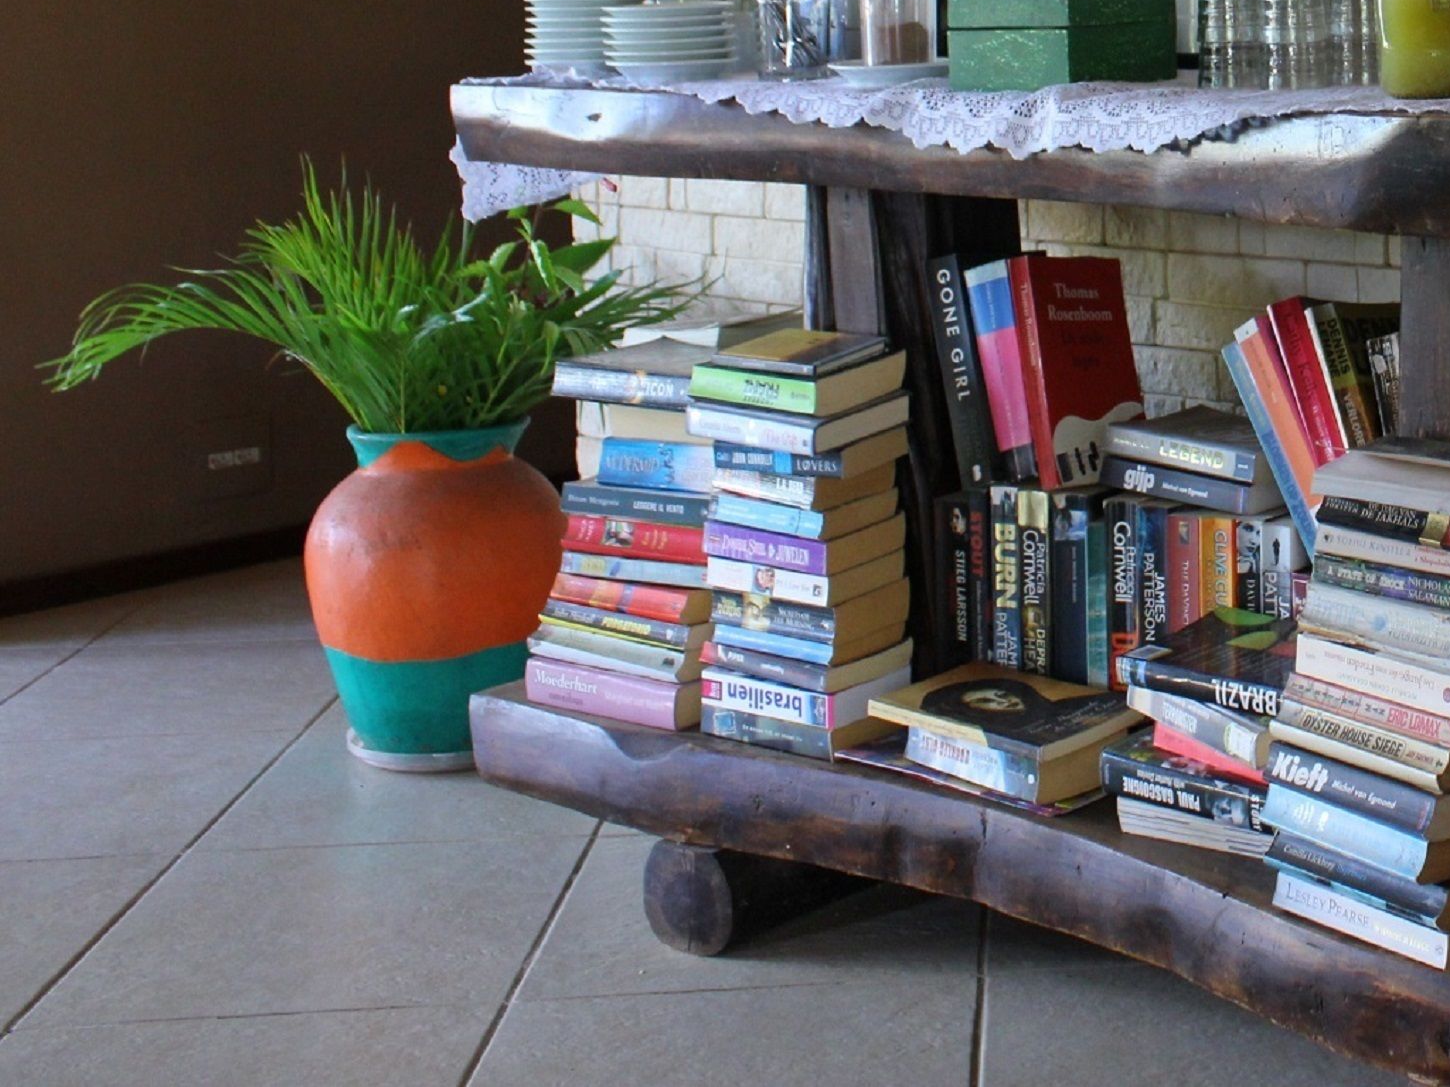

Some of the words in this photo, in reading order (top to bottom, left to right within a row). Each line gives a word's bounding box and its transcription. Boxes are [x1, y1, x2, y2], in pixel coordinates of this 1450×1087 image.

[1053, 282, 1100, 299] Thomas
[1048, 304, 1113, 322] Rosenboom
[936, 269, 961, 338] GONE
[951, 347, 971, 401] GIRL
[1327, 318, 1350, 375] DENNIS
[1159, 438, 1224, 469] LEGEND
[1123, 464, 1155, 493] gijp
[955, 549, 967, 584] STIEG
[994, 523, 1018, 609] BURN
[1023, 530, 1040, 604] Cornwell
[1036, 542, 1046, 594] Patricia
[1113, 521, 1133, 603] Cornwell
[1213, 530, 1229, 579] CLIVE
[956, 587, 968, 641] LARSSON
[1142, 552, 1156, 641] PATTERSON
[1153, 572, 1166, 624] JAMES
[1214, 581, 1229, 608] CU
[1246, 579, 1256, 611] DAVI
[1006, 631, 1018, 670] JAM
[533, 668, 598, 695] Moederhart
[727, 682, 803, 718] brasilien
[1211, 678, 1278, 716] BRAZIL
[1302, 711, 1341, 736] OYSTER
[1341, 723, 1373, 749] HOUSE
[1373, 735, 1405, 759] SIEGE
[1387, 706, 1408, 729] ERIC
[1408, 712, 1442, 739] LOMAX
[1271, 750, 1329, 794] Kieft
[1354, 787, 1368, 799] van
[1367, 791, 1397, 810] Egmond
[1177, 793, 1201, 812] PAUL
[1286, 882, 1327, 910] LESLEY
[1327, 898, 1370, 926] PEARSE
